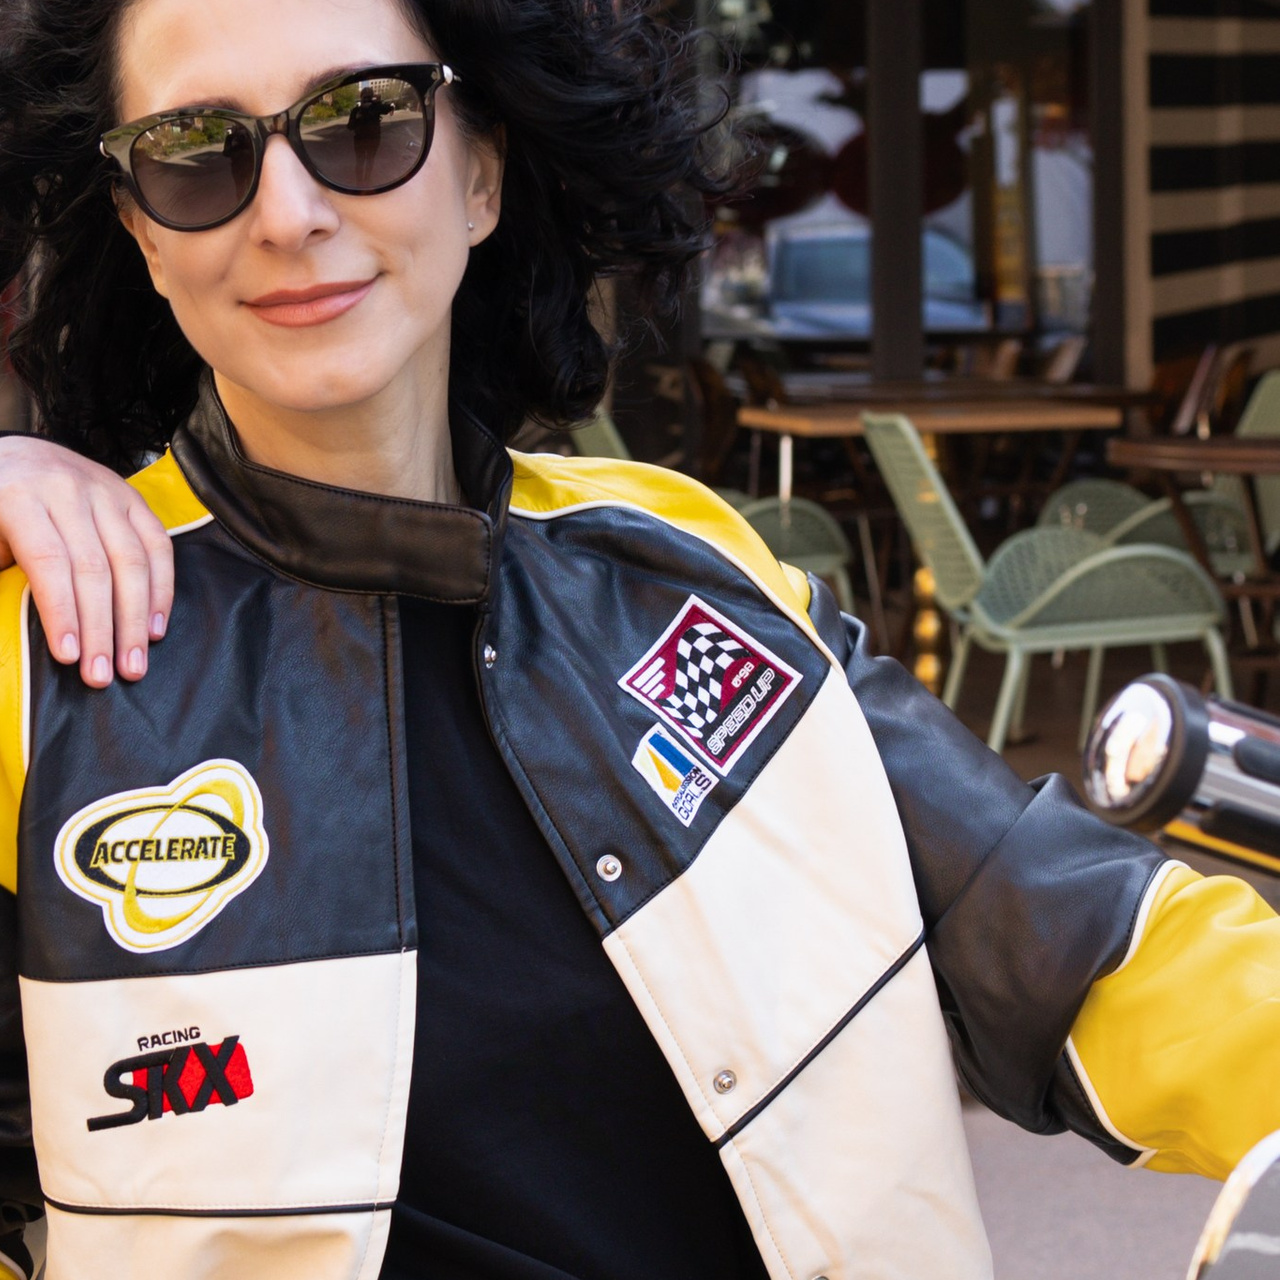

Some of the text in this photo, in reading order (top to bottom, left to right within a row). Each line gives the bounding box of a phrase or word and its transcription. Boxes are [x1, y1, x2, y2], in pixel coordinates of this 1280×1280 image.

[678, 774, 712, 821] GOALS
[90, 832, 238, 870] ACCELERATE
[137, 1026, 201, 1052] RACING
